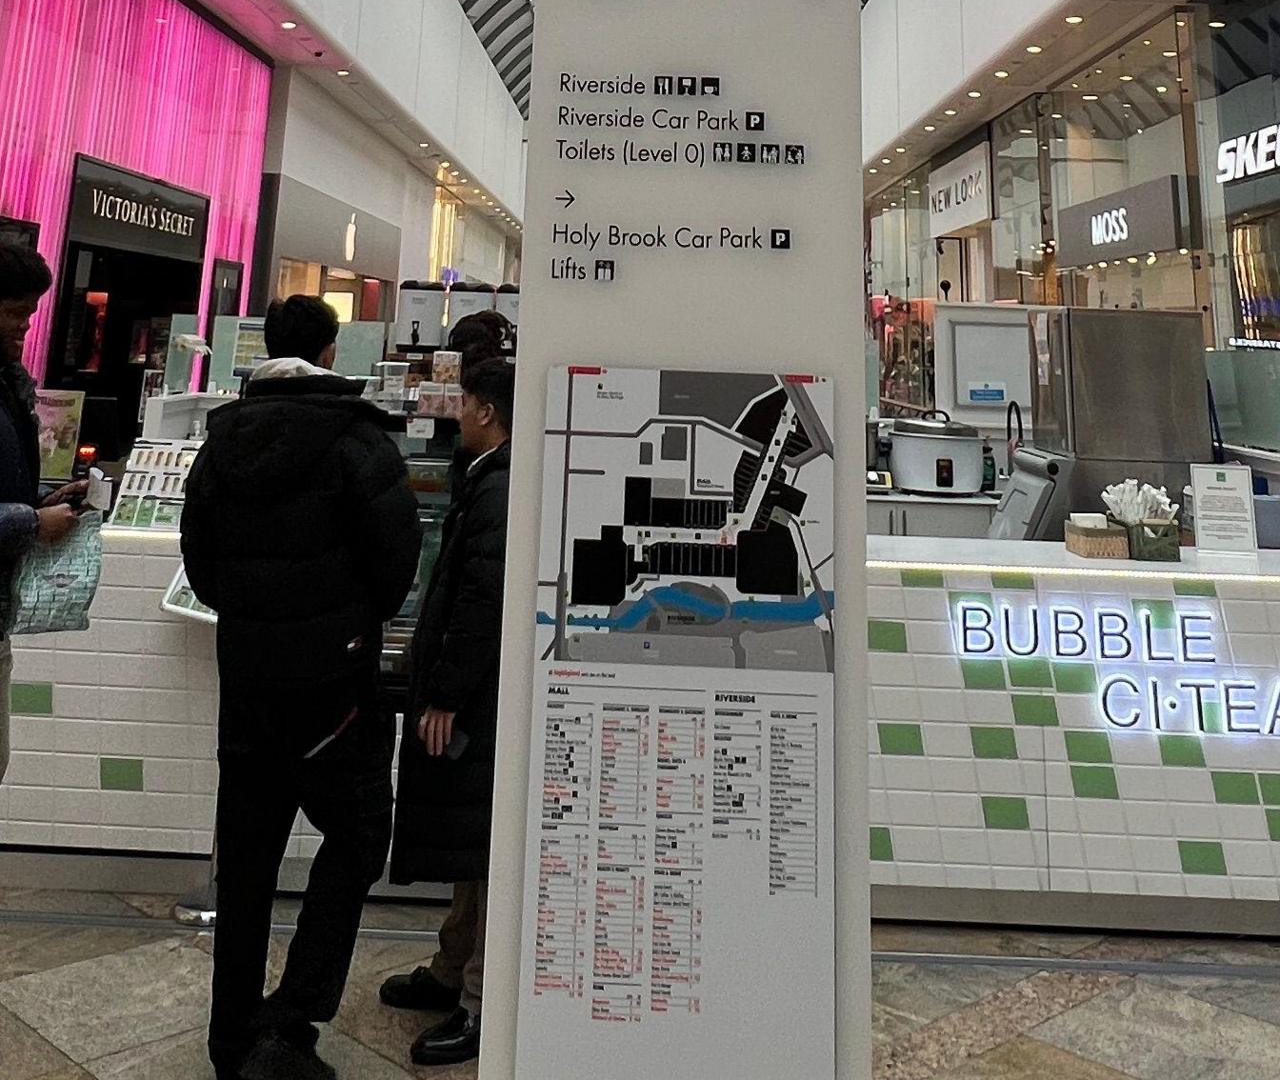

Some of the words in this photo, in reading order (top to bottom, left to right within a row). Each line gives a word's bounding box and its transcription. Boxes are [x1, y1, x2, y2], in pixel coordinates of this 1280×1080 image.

[559, 73, 645, 94] Riverside
[557, 106, 644, 128] Riverside
[652, 109, 689, 129] Car
[697, 110, 739, 131] Park
[556, 138, 615, 161] Toilets
[623, 139, 678, 165] (Level
[685, 141, 705, 167] 0)
[931, 186, 952, 215] NEW
[955, 170, 983, 206] LOOK
[93, 188, 158, 229] VICTORIA'S
[158, 207, 195, 236] SECRET
[1091, 207, 1129, 246] MOSS
[552, 223, 600, 251] Holy
[608, 225, 667, 248] Brook
[674, 227, 712, 249] Car
[720, 226, 762, 249] Park
[551, 257, 587, 280] Lifts
[959, 604, 1216, 664] BUBBLE
